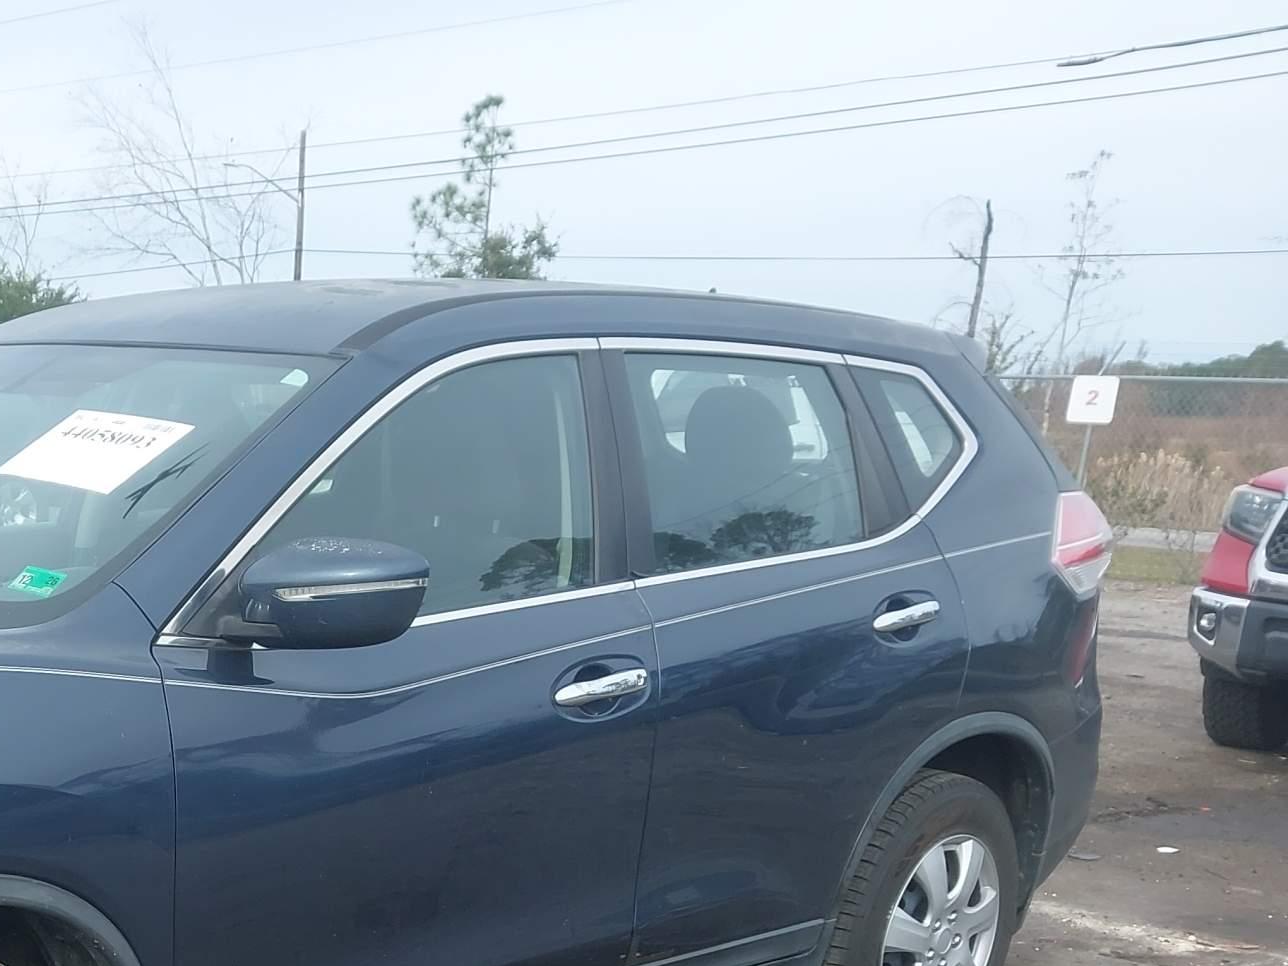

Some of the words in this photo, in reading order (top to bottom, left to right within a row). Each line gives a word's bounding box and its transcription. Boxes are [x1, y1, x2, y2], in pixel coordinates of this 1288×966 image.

[1085, 389, 1100, 406] 2
[60, 425, 158, 449] 44058093
[18, 574, 34, 585] 12
